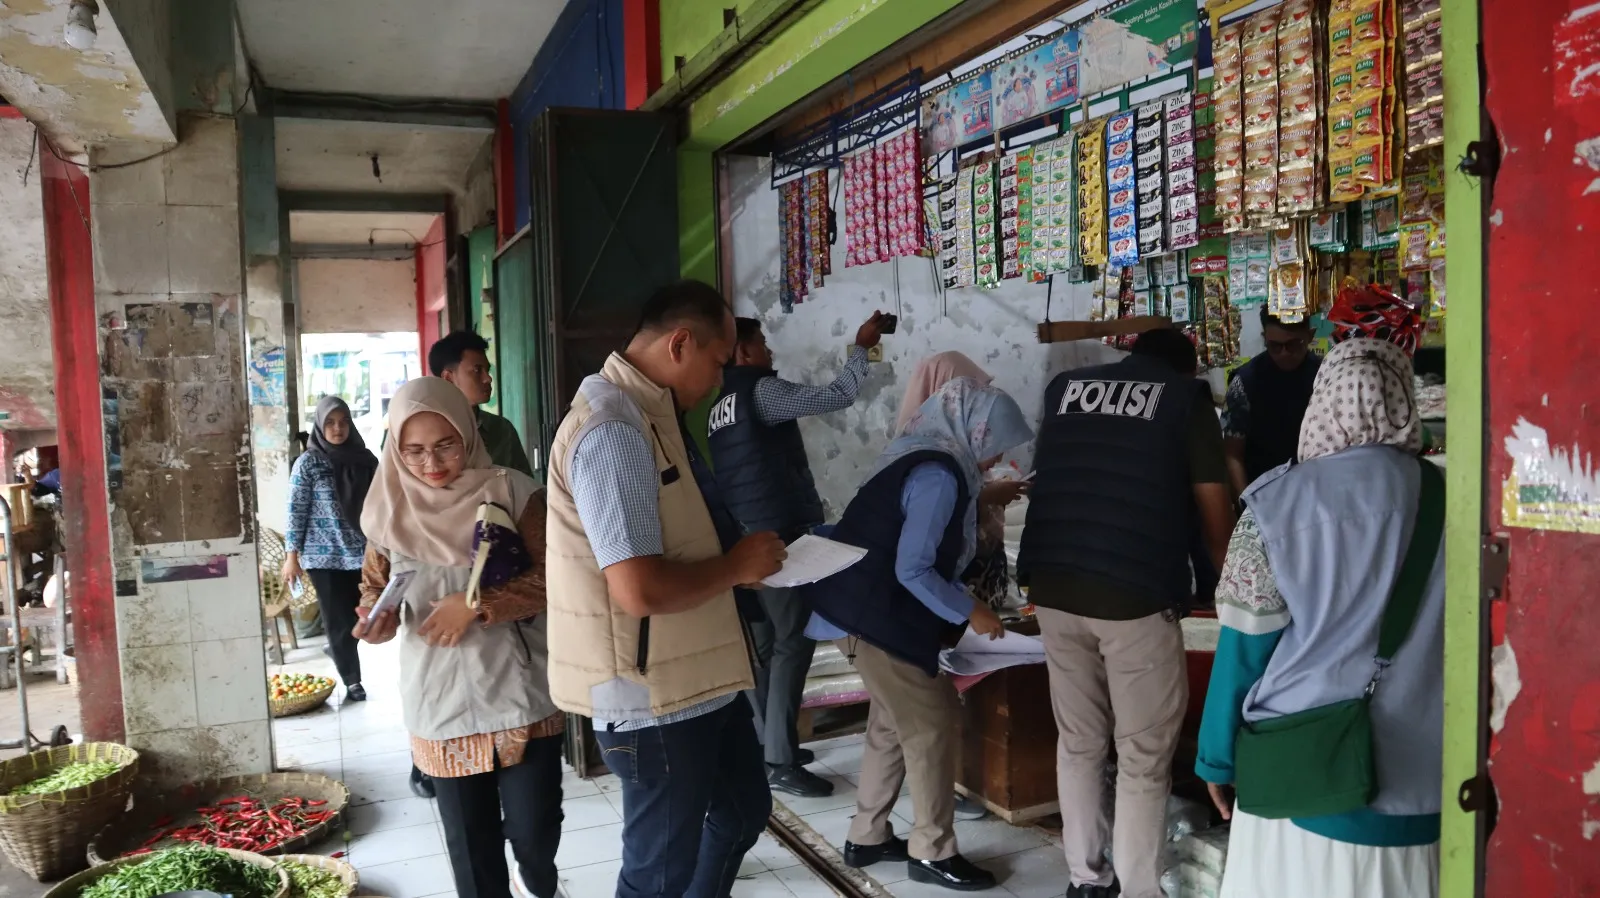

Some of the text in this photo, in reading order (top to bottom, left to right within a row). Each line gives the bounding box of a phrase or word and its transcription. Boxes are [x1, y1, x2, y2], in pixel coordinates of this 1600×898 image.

[1357, 13, 1373, 23] AMH
[1334, 29, 1350, 38] AMH
[1357, 60, 1374, 70] AMH
[1335, 75, 1351, 84] AMH
[1170, 95, 1185, 107] ZINC
[1138, 104, 1161, 116] PANTENE
[1356, 108, 1372, 117] AMH
[1171, 120, 1186, 133] ZINC
[1136, 128, 1159, 140] PANTENE
[1172, 145, 1187, 157] ZINC
[1138, 154, 1160, 165] PANTENE
[1357, 155, 1373, 165] AMH
[1172, 171, 1188, 183] ZINC
[1175, 196, 1190, 208] ZINC
[1175, 222, 1191, 234] ZINC
[1059, 381, 1162, 419] POLISI
